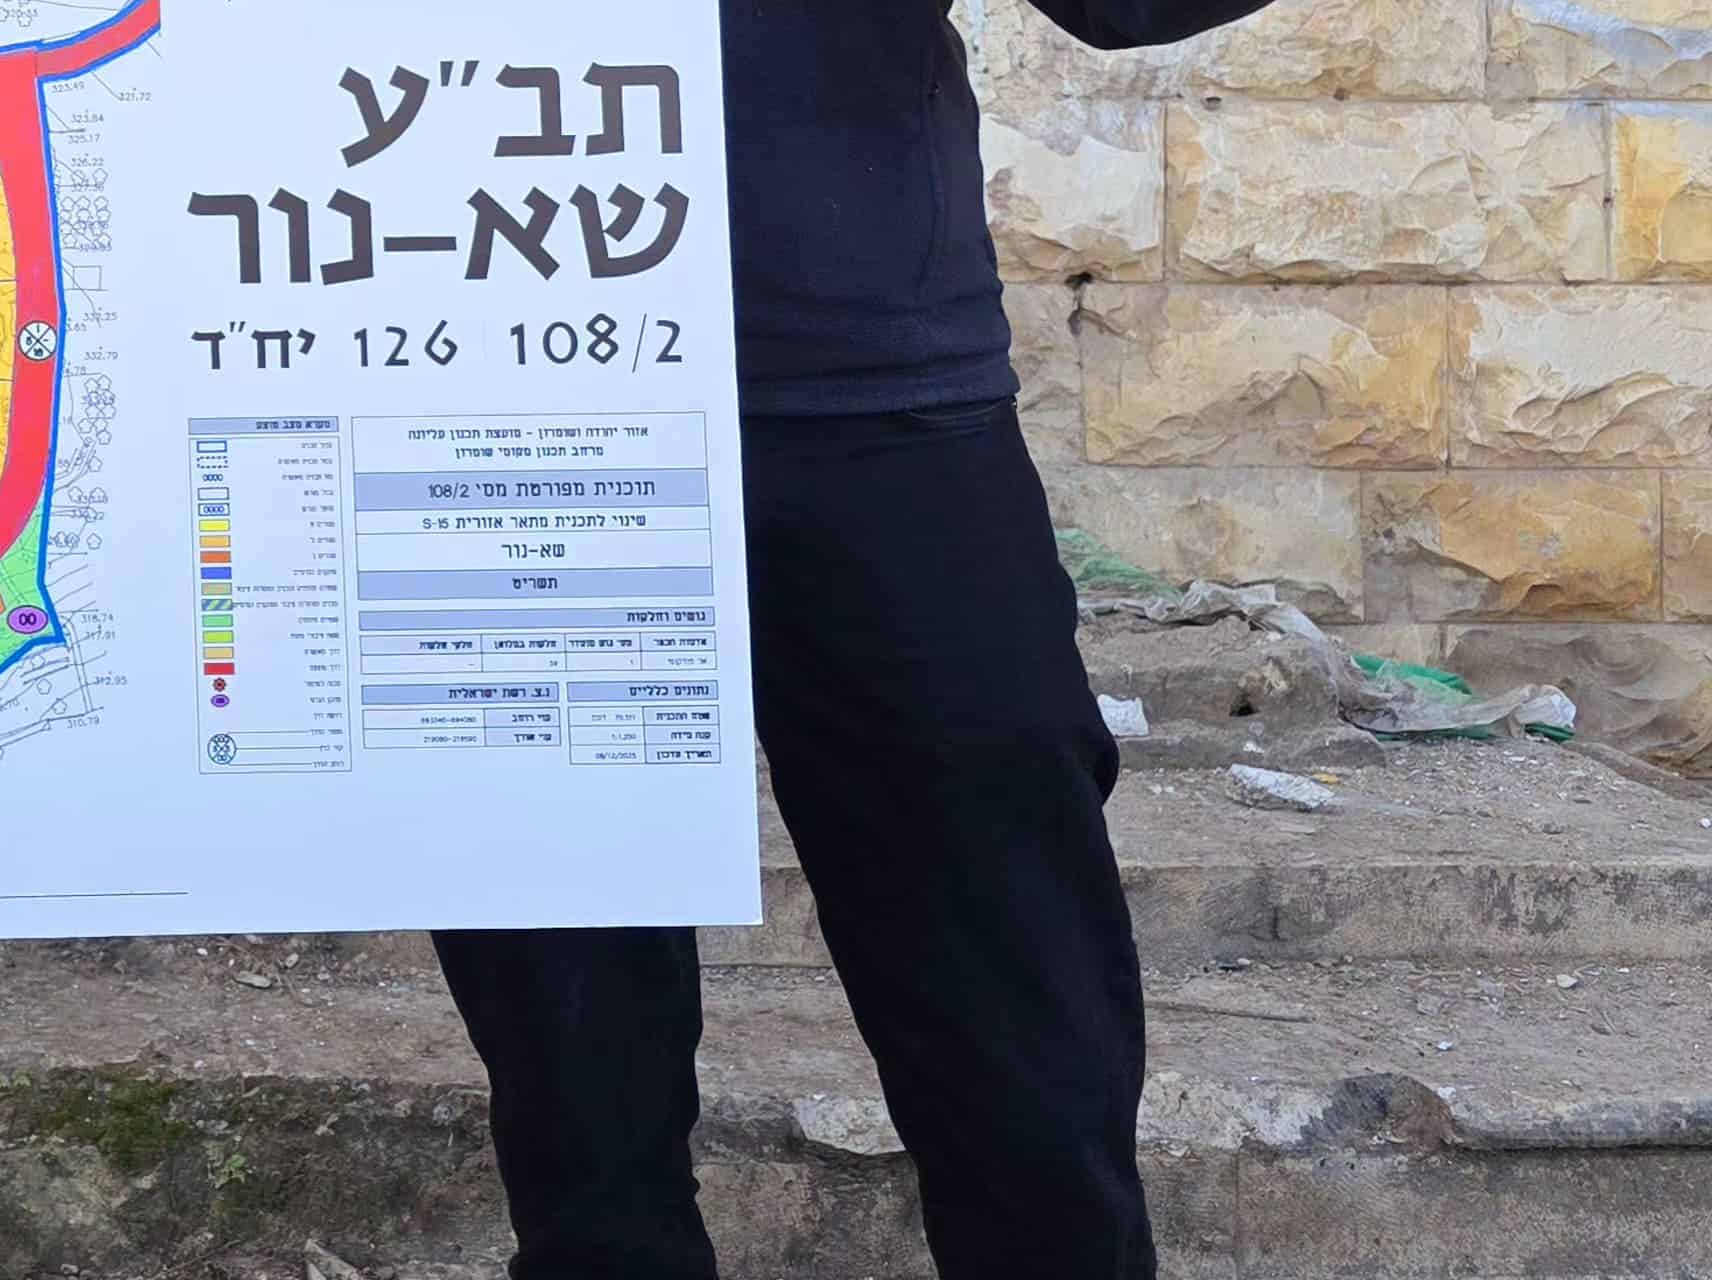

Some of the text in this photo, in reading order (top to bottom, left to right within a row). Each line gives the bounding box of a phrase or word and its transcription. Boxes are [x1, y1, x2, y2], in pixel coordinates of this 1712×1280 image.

[339, 60, 682, 168] תב"ע
[191, 313, 684, 374] 108/2 126 יח"ד
[409, 427, 648, 442] אזור יהודה ושומרון מועצת תכנון עליונה
[455, 446, 603, 459] מרחב תכנון מקומי שומרון
[428, 484, 470, 499] 108/2
[516, 482, 585, 497] מפורטת
[594, 481, 655, 496] תוכנית
[456, 517, 502, 529] אזורית
[511, 516, 548, 528] מתאר
[555, 514, 605, 528] לתכנית
[612, 515, 646, 527] שינוי
[501, 544, 565, 558] שא-נור
[513, 577, 557, 589] תשריט
[628, 612, 705, 623] גושים וחלקות
[449, 689, 498, 699] ישראלית
[629, 685, 709, 696] נתונים כלליים
